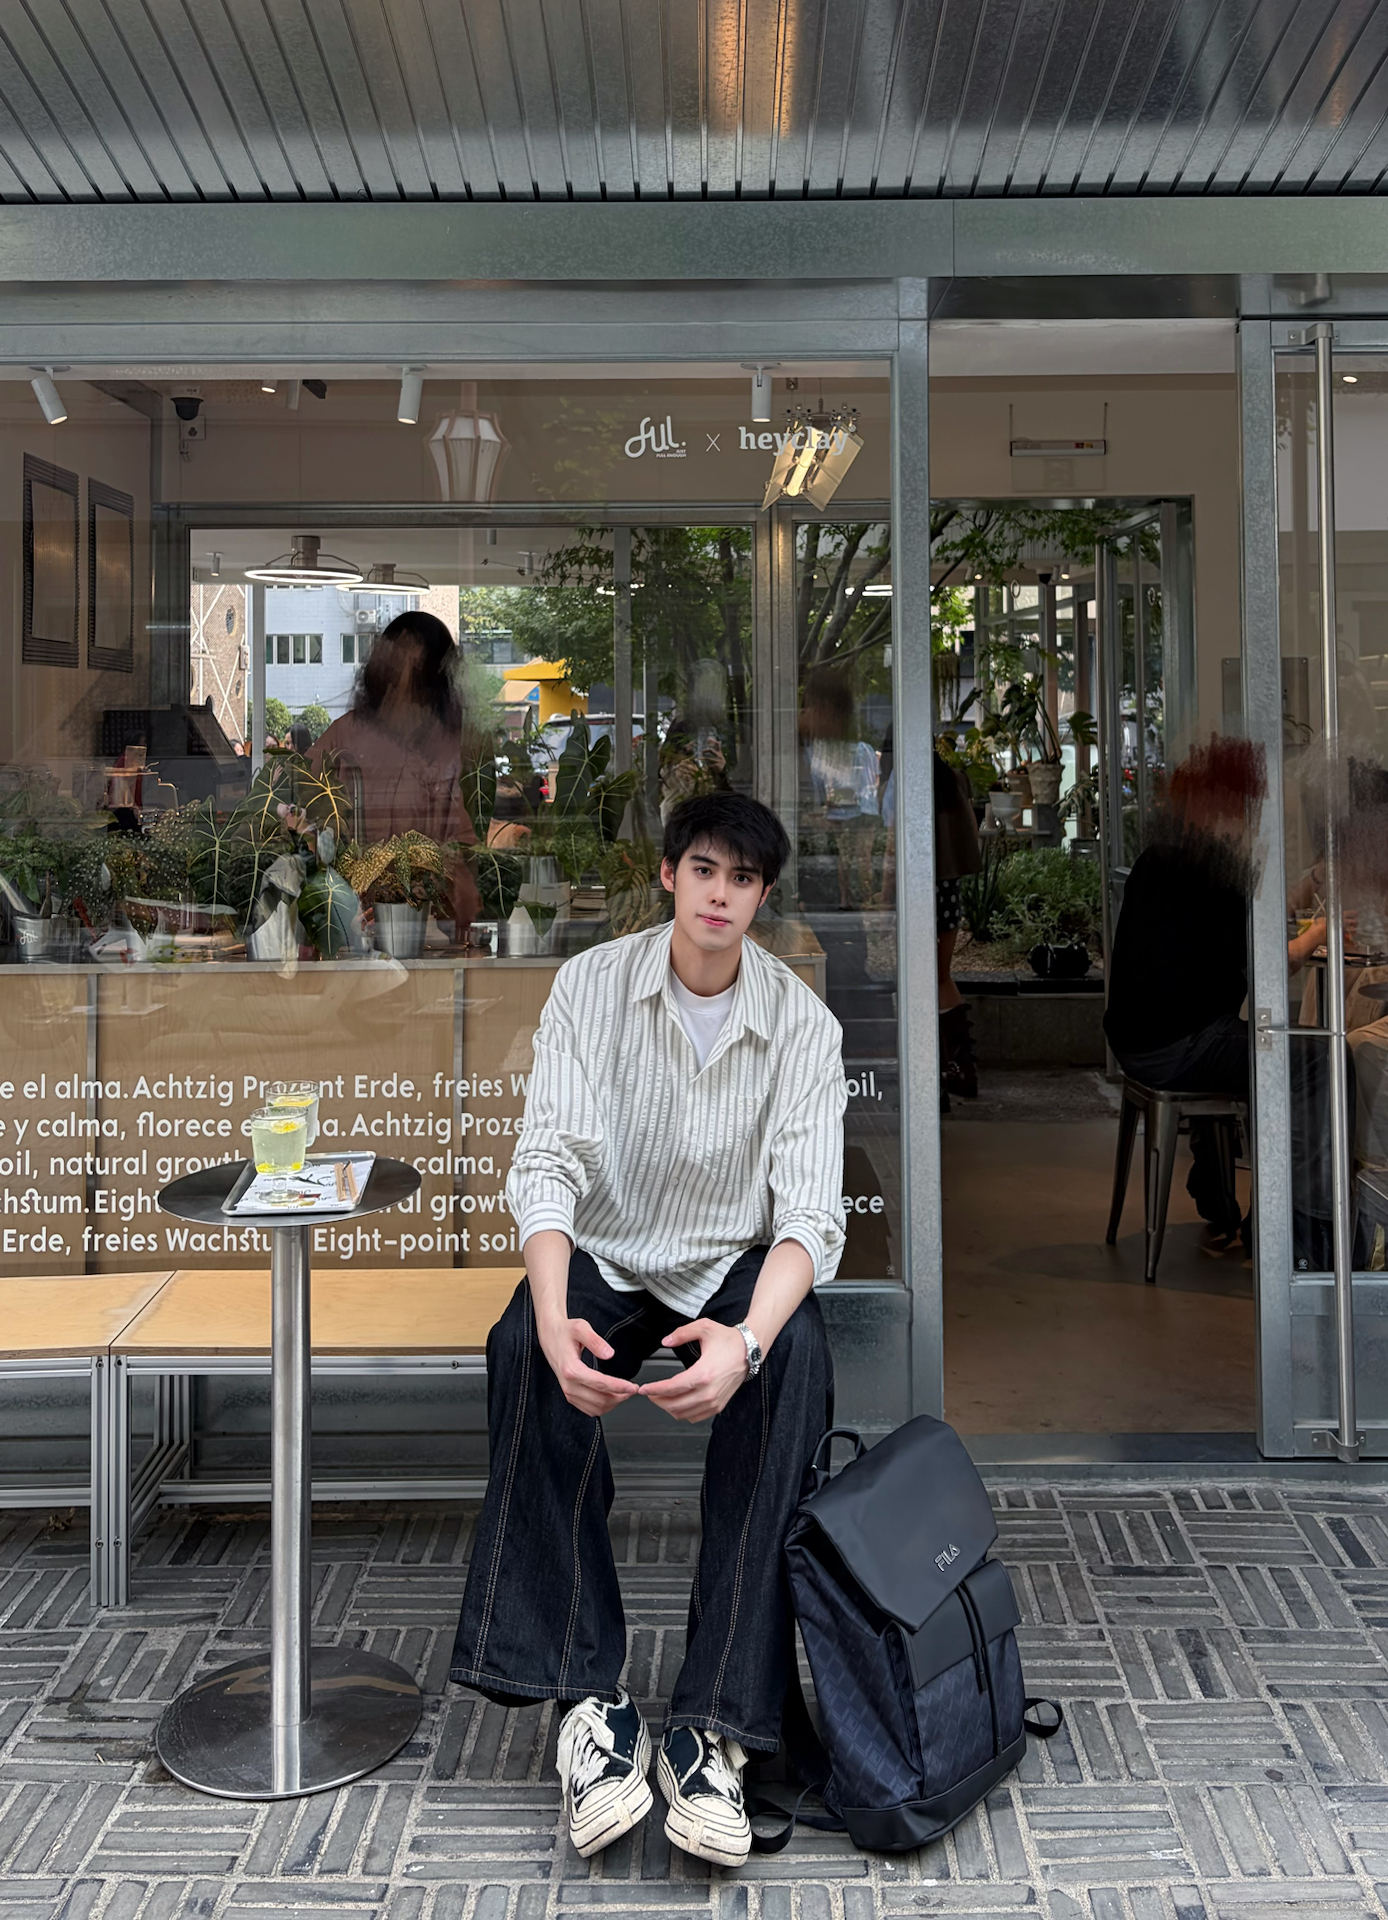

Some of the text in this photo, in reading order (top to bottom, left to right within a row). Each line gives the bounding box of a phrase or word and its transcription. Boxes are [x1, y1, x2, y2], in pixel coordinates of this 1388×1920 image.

[738, 426, 849, 457] heyclay
[23, 1073, 46, 1099] el
[354, 1072, 422, 1102] Erde,
[433, 1072, 503, 1098] freies
[13, 1119, 30, 1145] y
[37, 1111, 126, 1141] calma,
[136, 1111, 233, 1137] florece
[50, 1149, 148, 1176] natural
[413, 1148, 502, 1179] calma,
[3, 1226, 71, 1256] Erde,
[82, 1226, 158, 1252] freies
[314, 1225, 471, 1260] Eight-point
[934, 1543, 961, 1572] FILA
